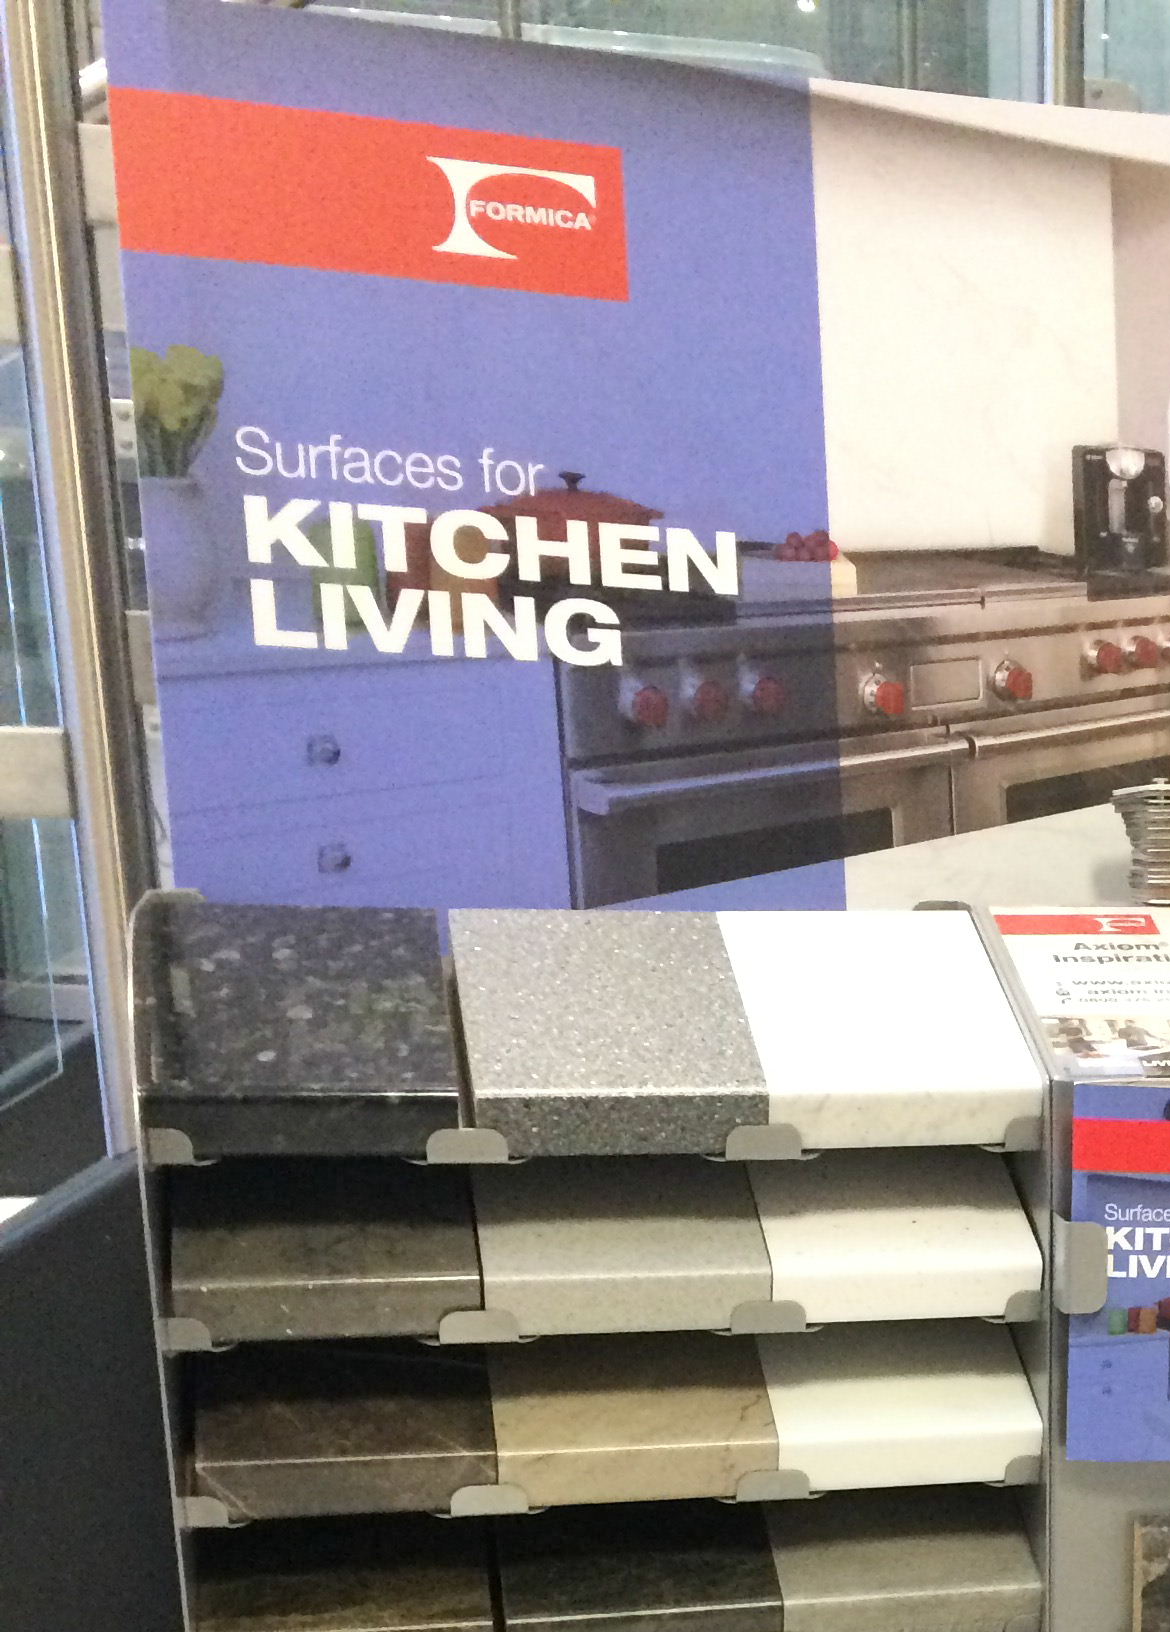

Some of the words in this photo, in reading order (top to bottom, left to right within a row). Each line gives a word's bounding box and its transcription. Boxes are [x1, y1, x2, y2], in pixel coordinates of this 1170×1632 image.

[469, 199, 592, 231] FORMICA
[235, 427, 463, 492] Surfaces
[478, 447, 544, 497] for
[242, 495, 740, 597] KITCHEN
[250, 578, 623, 667] LIVING
